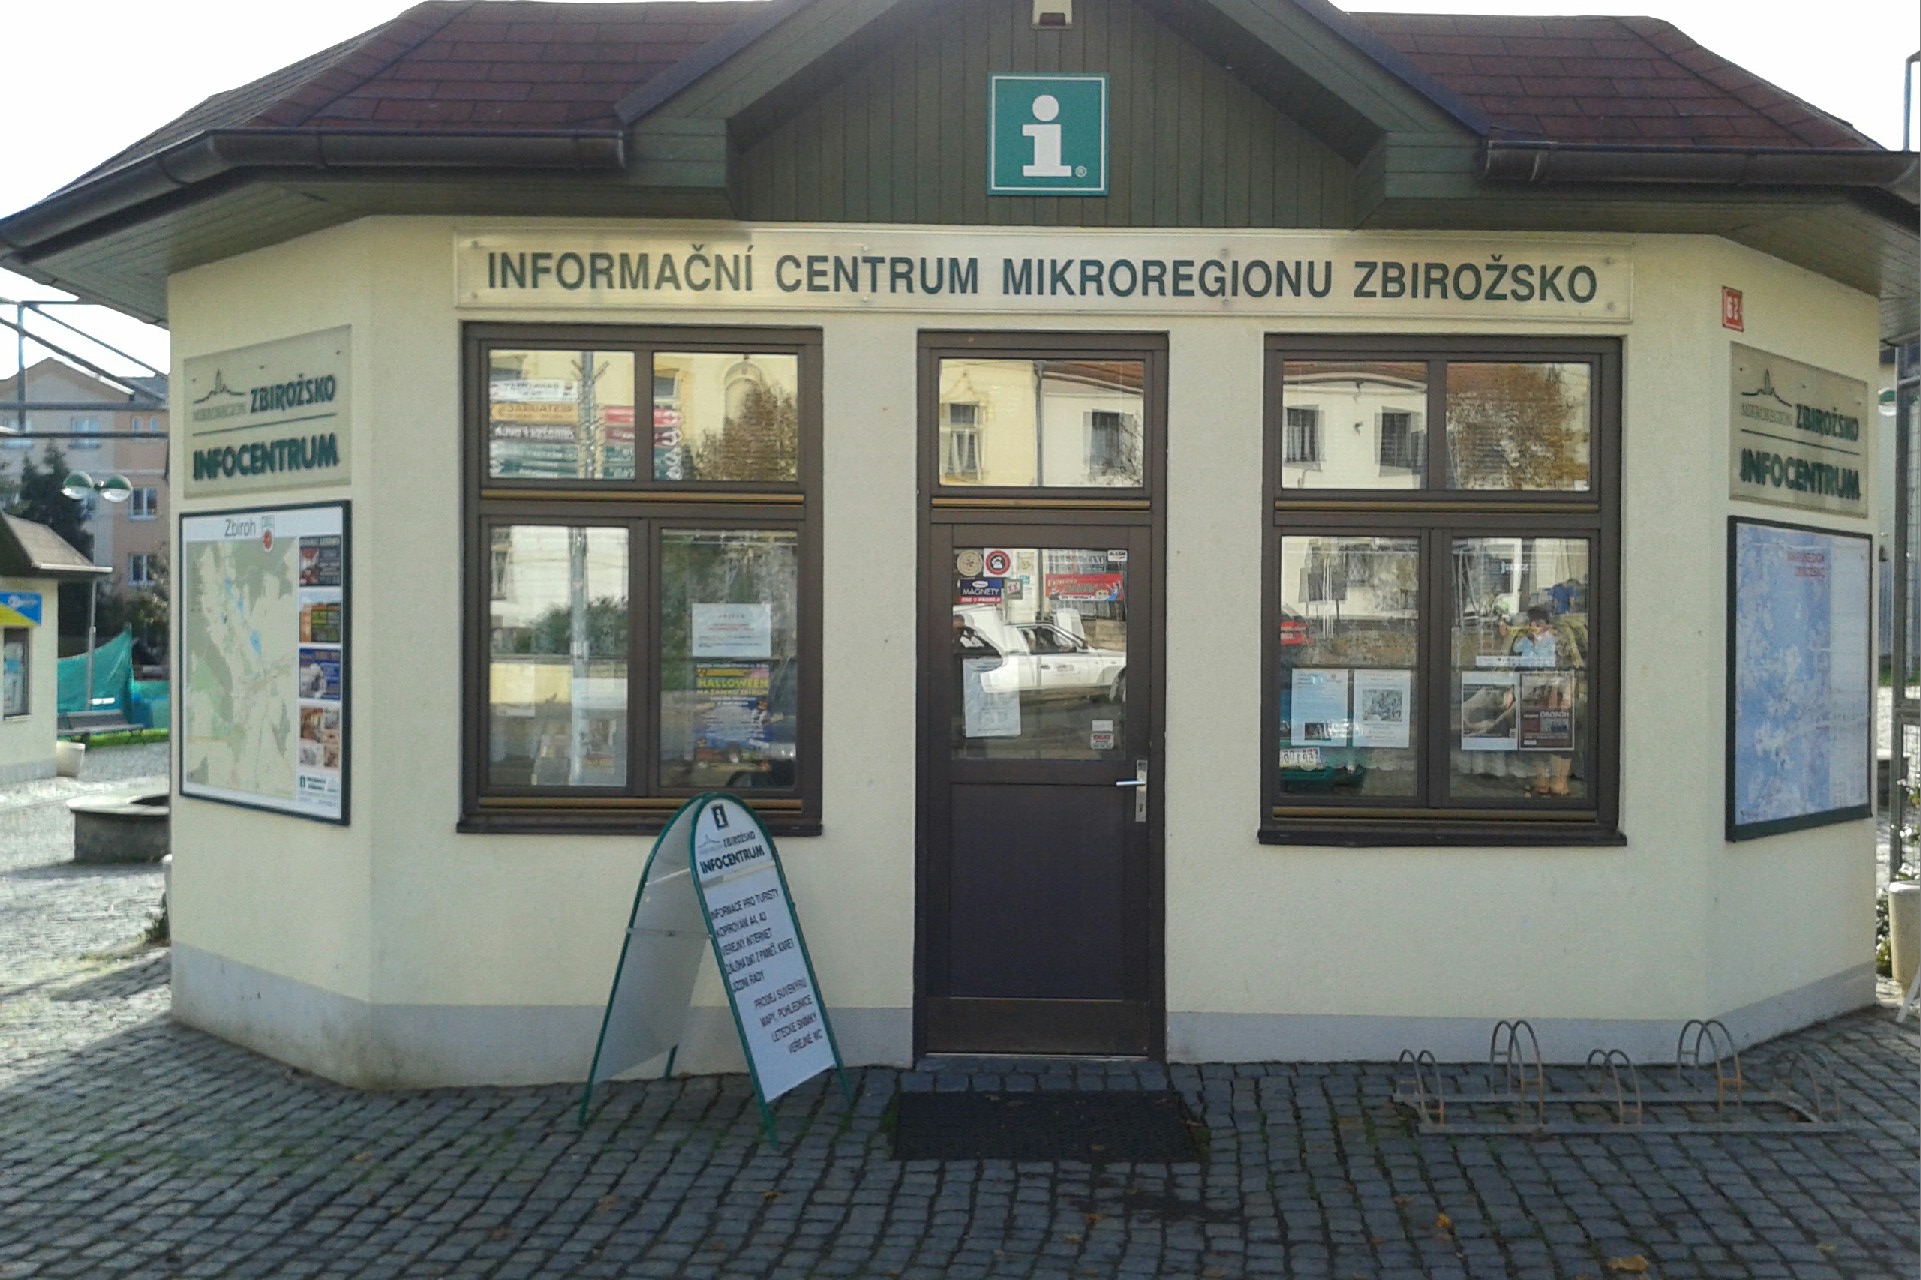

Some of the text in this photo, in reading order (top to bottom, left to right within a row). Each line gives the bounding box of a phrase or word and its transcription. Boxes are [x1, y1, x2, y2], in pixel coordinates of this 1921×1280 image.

[488, 245, 1597, 304] INFORMAČNÍ CENTRUM MIKROREGIONU ZBIROŽSKO
[250, 372, 336, 414] ZBIROŽSKO
[193, 432, 340, 481] INFOCENTRUM
[1740, 447, 1861, 500] INFOCENTRUM
[697, 679, 768, 688] HALLOWEEN
[699, 844, 765, 874] INFOCENTRUM
